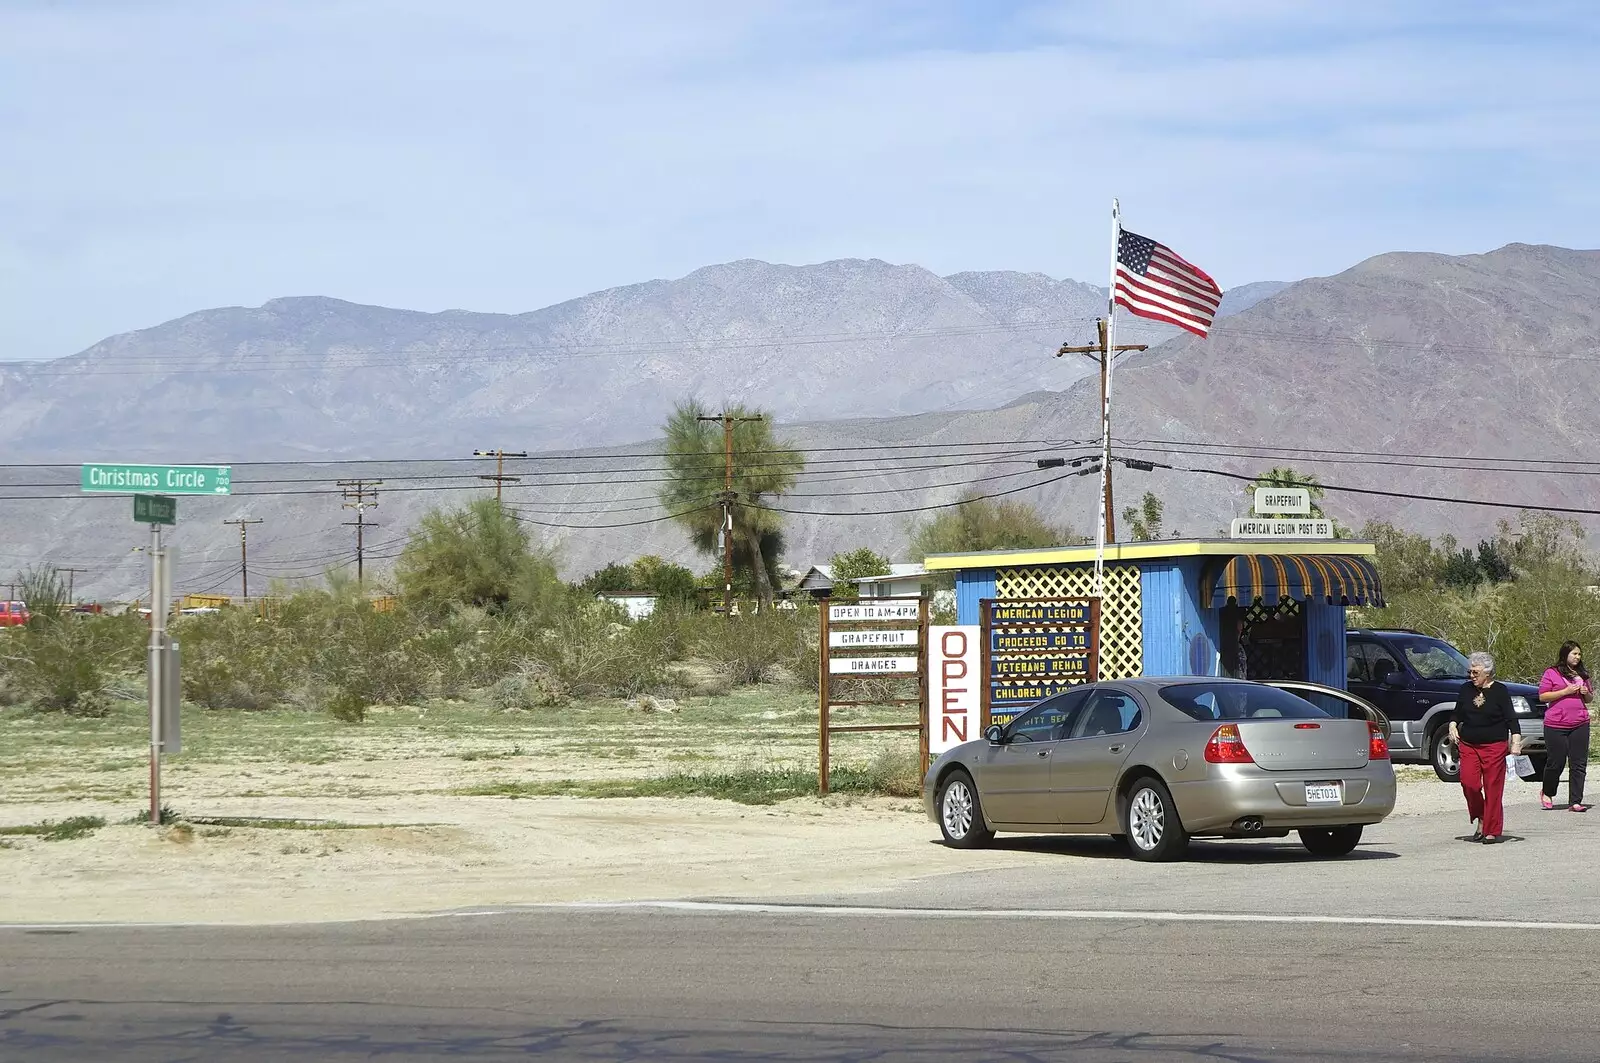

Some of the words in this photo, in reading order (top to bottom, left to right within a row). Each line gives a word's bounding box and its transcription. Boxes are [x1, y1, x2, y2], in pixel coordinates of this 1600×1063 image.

[90, 467, 159, 487] Christmas
[167, 469, 206, 488] Circle
[215, 477, 230, 485] 700
[1265, 495, 1302, 507] GRAPEFRUIT
[1238, 523, 1271, 535] AMERICAN
[1274, 523, 1296, 535] LEGION
[1299, 523, 1313, 534] POST
[834, 608, 860, 618] OPEN
[864, 608, 874, 617] 10
[995, 609, 1043, 619] AMERICAN
[1048, 609, 1083, 618] LEGION
[842, 633, 905, 643] GRAPEFRUIT
[998, 636, 1048, 647] PROCEEDS
[1055, 636, 1067, 645] GO
[1073, 635, 1085, 644] TO
[851, 660, 897, 670] ORANGES
[997, 662, 1045, 672] VETERANS
[1052, 660, 1083, 671] REHAB
[941, 631, 968, 742] OPEN
[995, 688, 1042, 698] CHILDREN
[1045, 687, 1052, 696] &
[1307, 788, 1338, 800] 5HET031
